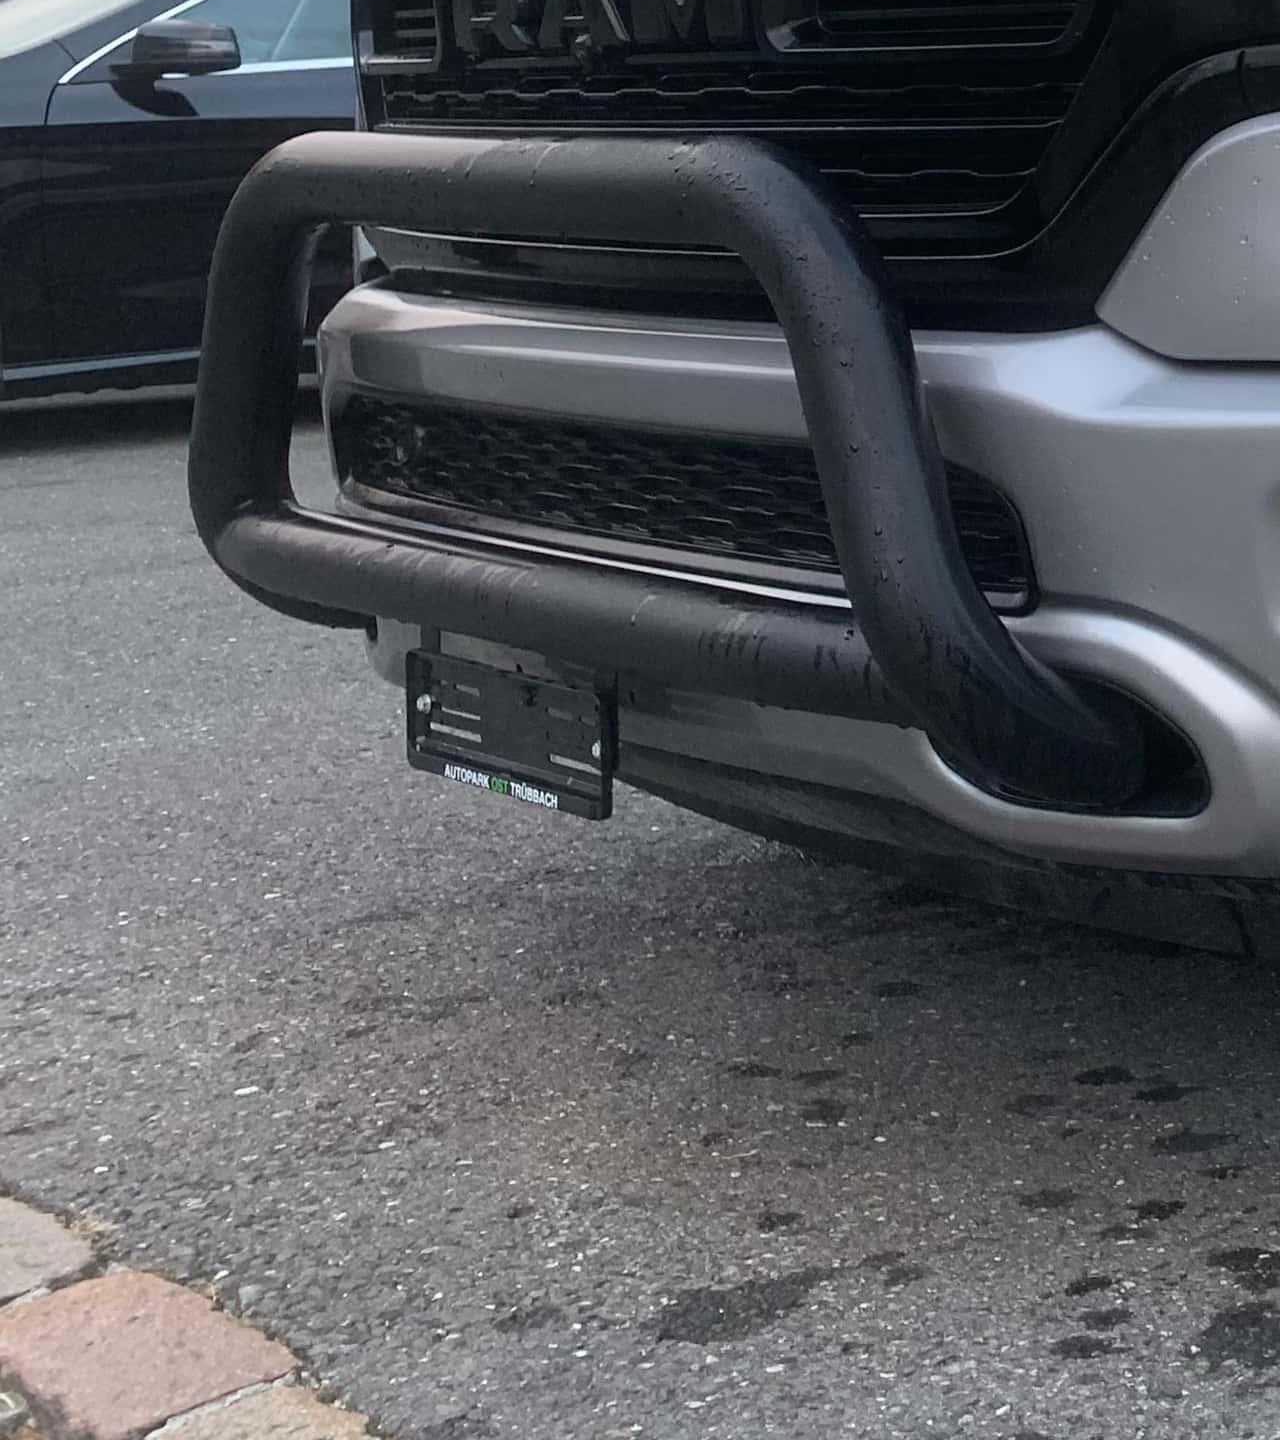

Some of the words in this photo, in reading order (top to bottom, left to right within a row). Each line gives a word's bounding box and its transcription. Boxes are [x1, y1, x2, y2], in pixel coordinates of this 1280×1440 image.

[444, 763, 490, 789] AUTOPARK
[490, 776, 508, 794] OST
[510, 782, 559, 808] TRÜBBACH
